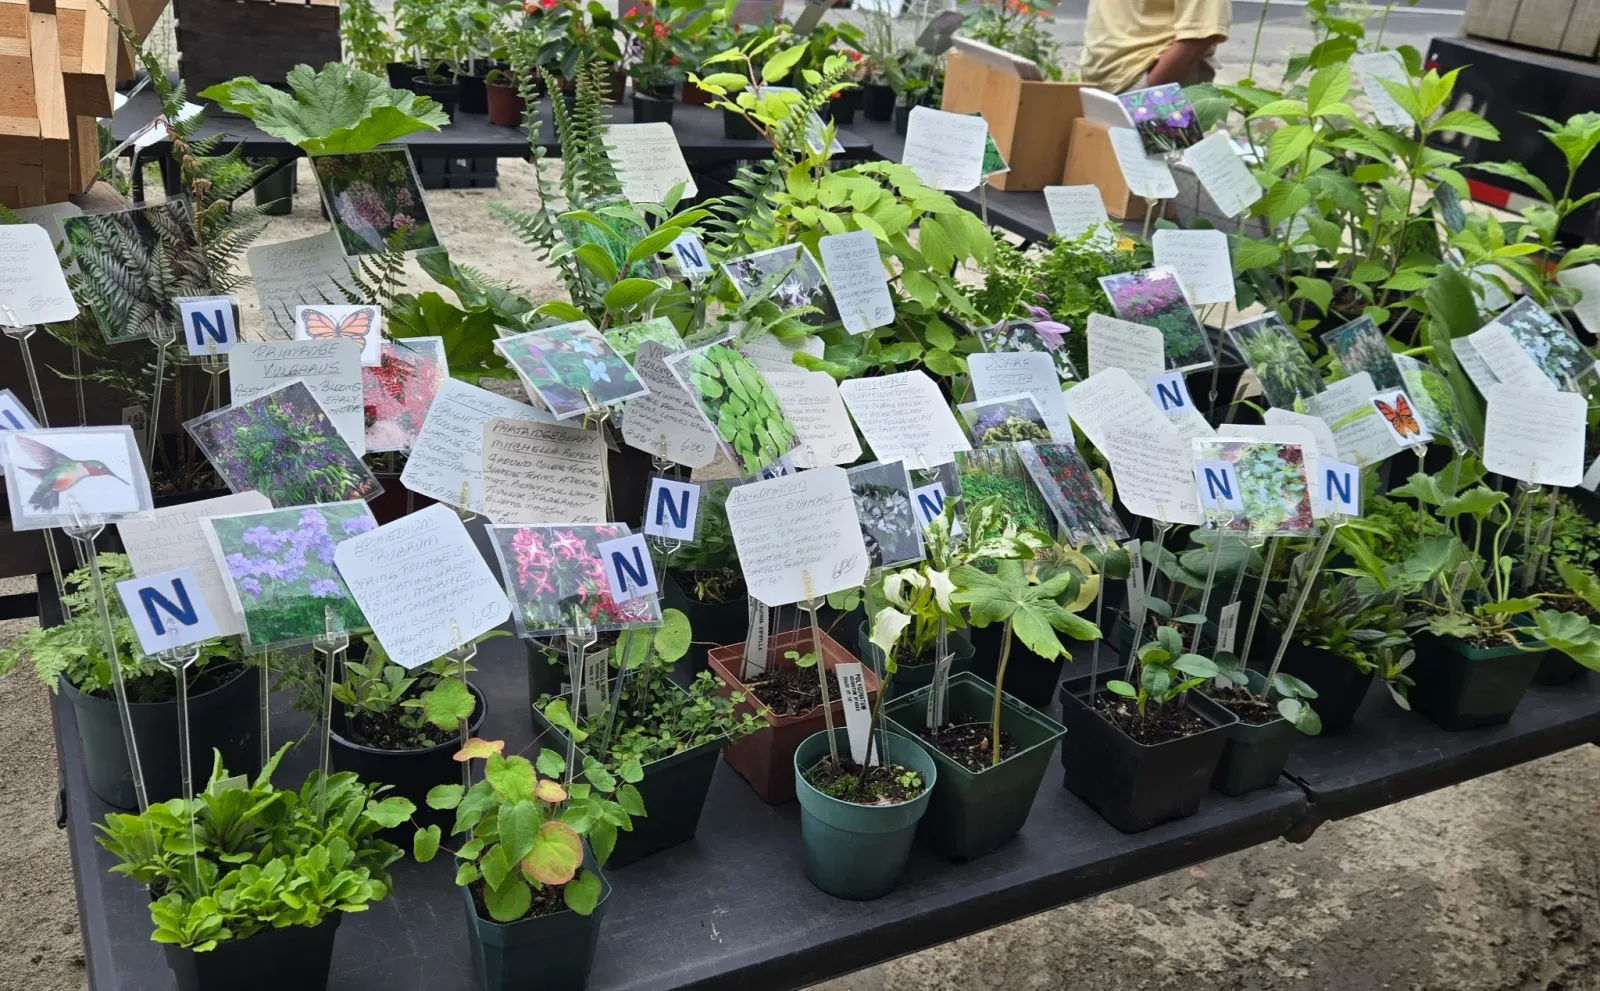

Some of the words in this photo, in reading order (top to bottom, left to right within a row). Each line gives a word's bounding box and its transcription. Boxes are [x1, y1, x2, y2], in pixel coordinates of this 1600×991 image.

[676, 242, 703, 269] N
[191, 309, 229, 346] N
[985, 356, 1032, 370] DWARF
[318, 380, 363, 393] BLOOMS
[1156, 380, 1185, 411] N
[431, 401, 474, 424] BRIGHT
[492, 421, 598, 444] PARTRIDGEBERRY
[420, 437, 463, 461] BLOOMS
[491, 439, 559, 456] MITCHELLA
[562, 448, 600, 461] REPENS
[483, 464, 521, 478] SHADE
[521, 471, 555, 483] FORMS
[488, 454, 532, 468] GROUND
[536, 460, 566, 473] COVER
[511, 480, 567, 495] BEAUTIFUL
[1204, 467, 1233, 501] N
[1326, 469, 1351, 504] N
[485, 495, 522, 508] BLOOMS
[656, 487, 690, 529] N
[918, 489, 944, 523] N
[355, 517, 436, 555] EPIMEDIUM
[371, 534, 439, 564] RUBRUM
[352, 571, 398, 591] SPRING
[398, 552, 451, 576] FOLIAGE
[433, 556, 477, 579] GREEN
[611, 546, 649, 593] N
[413, 571, 473, 598] ADORNED
[138, 577, 199, 636] N
[373, 608, 403, 626] WITH
[408, 602, 457, 627] BLOOMS
[855, 673, 868, 711] POLYGONATUM
